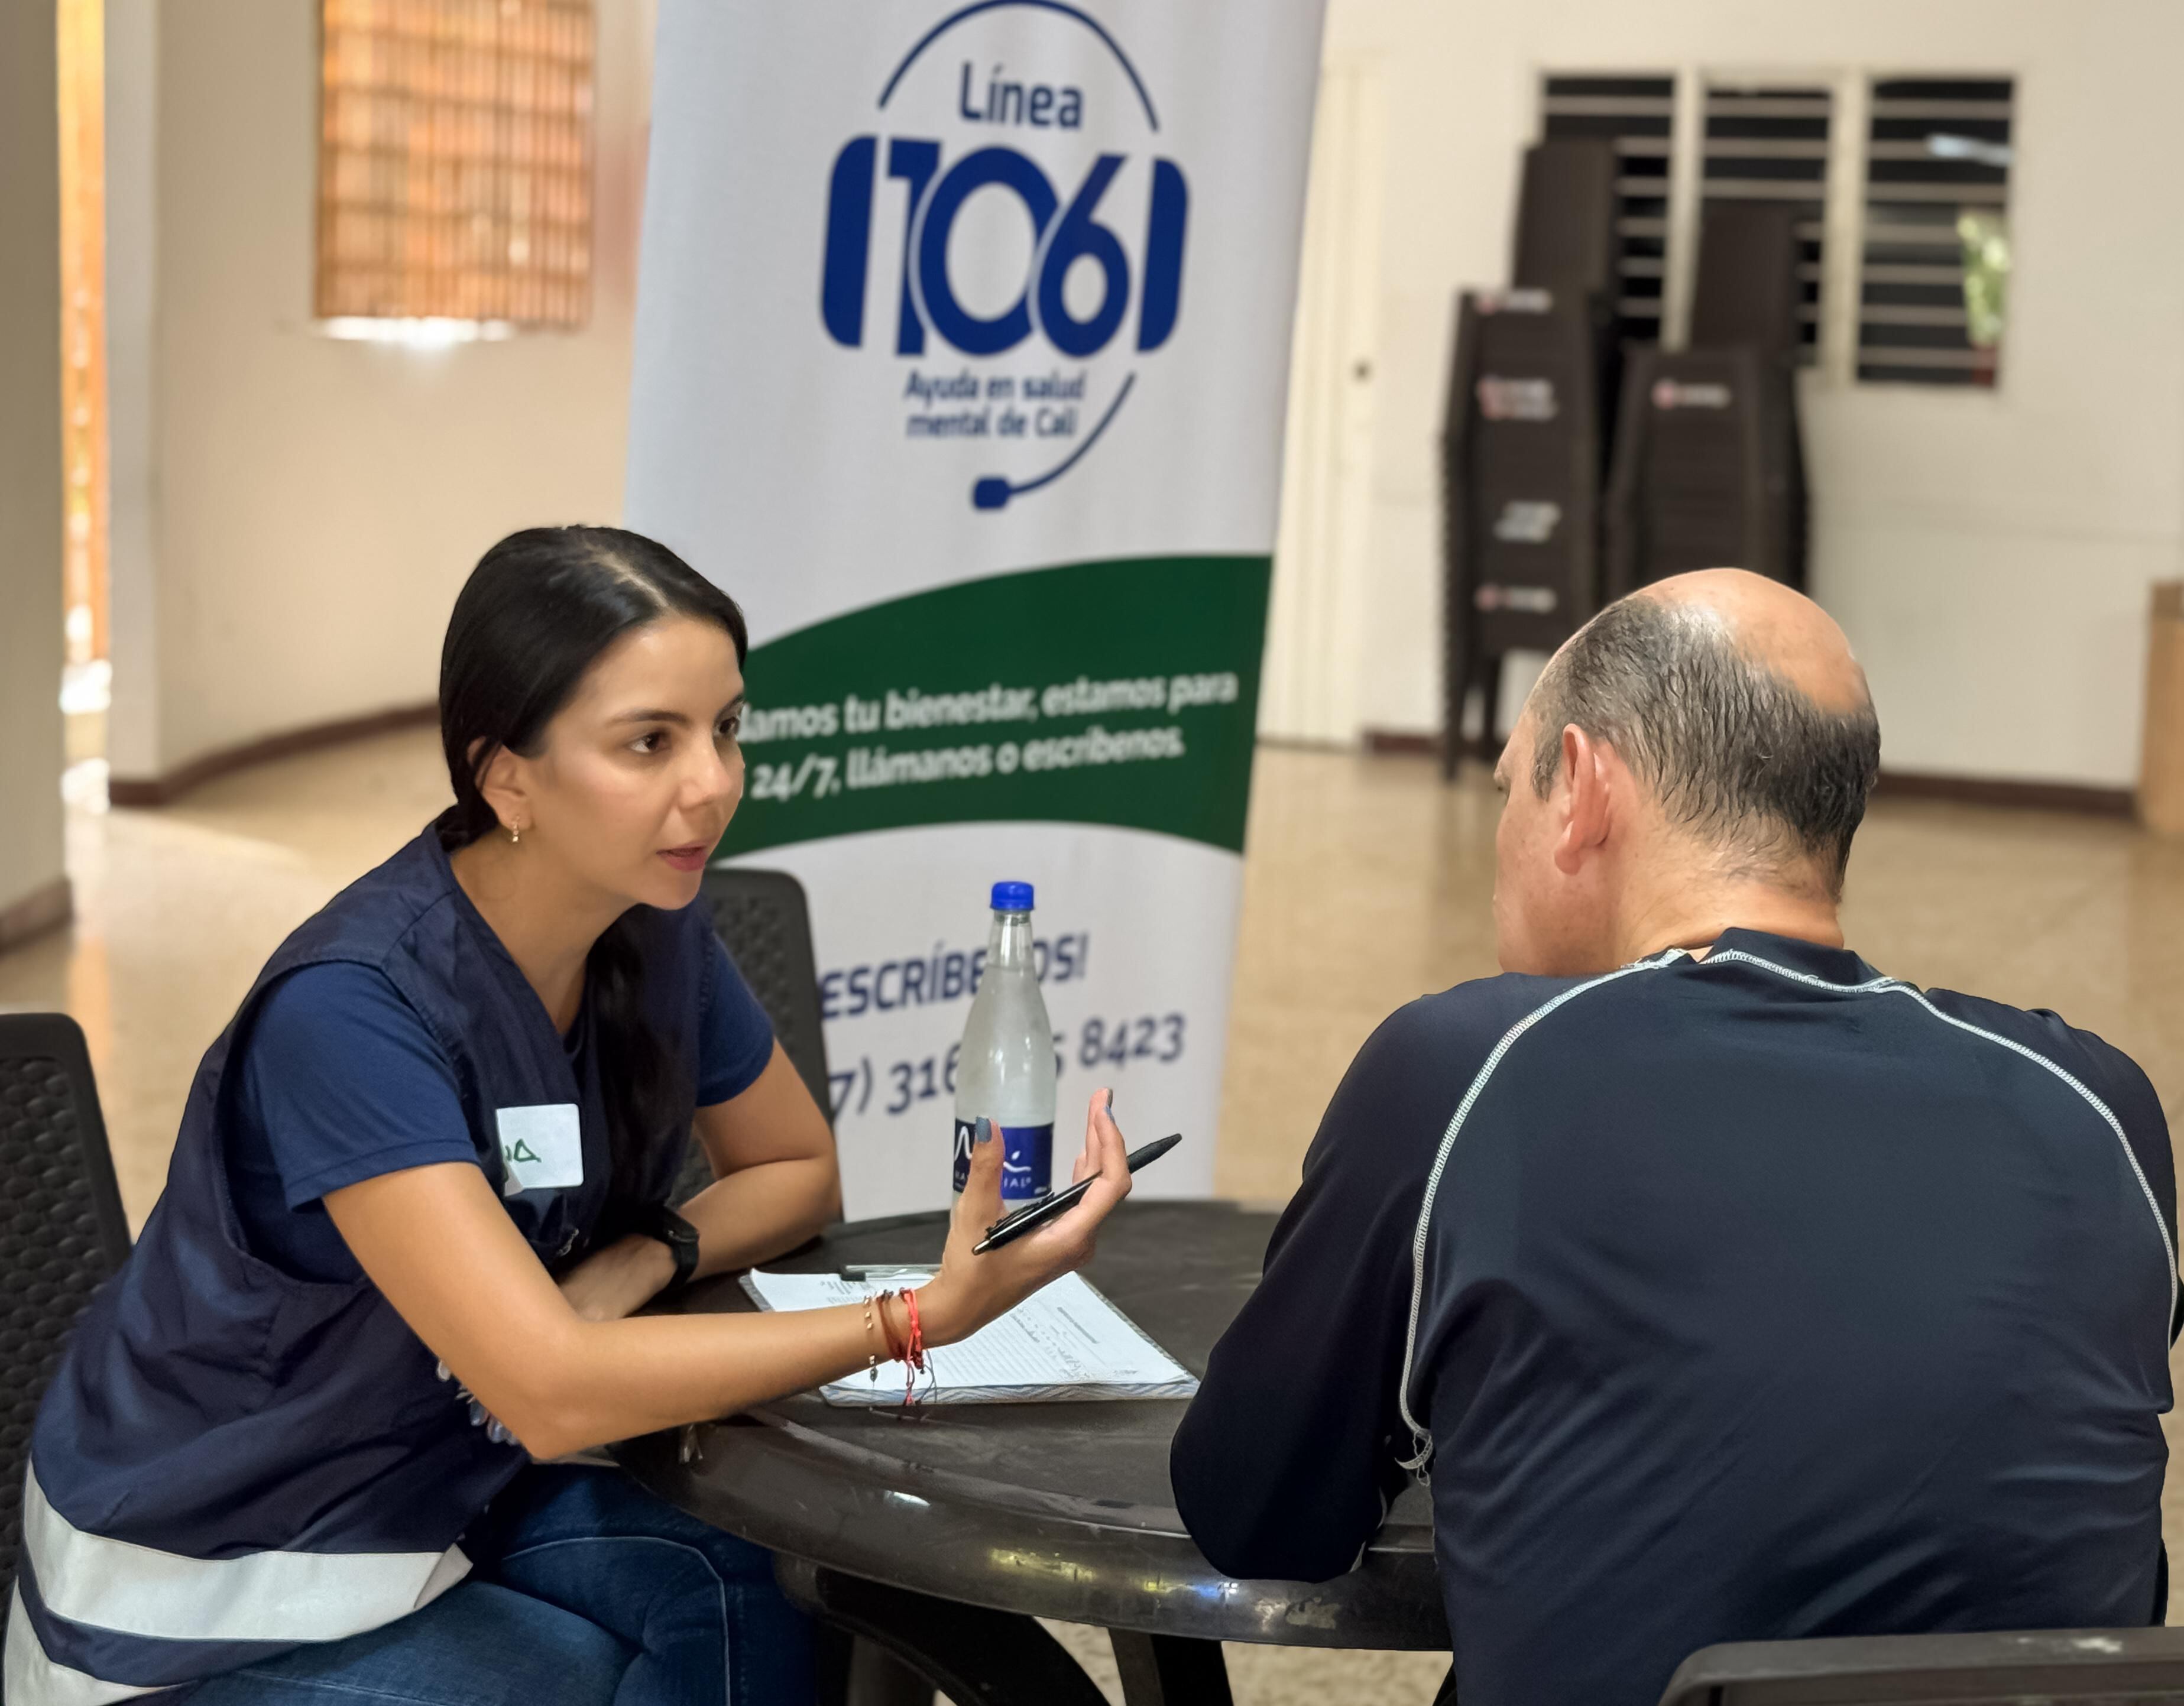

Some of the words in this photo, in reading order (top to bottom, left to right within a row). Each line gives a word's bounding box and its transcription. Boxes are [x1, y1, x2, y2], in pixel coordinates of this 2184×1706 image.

[959, 61, 1083, 128] Línea
[903, 369, 979, 408] Ayuda
[987, 376, 1015, 398] en
[1022, 369, 1086, 400] salud
[906, 407, 990, 437] mental
[997, 407, 1027, 436] de
[1036, 406, 1078, 437] Cali
[844, 695, 880, 734] tu
[884, 682, 1039, 730] bienestar,
[1042, 675, 1166, 718] estamos
[1167, 672, 1239, 716] para
[846, 745, 993, 790] llámanos
[996, 741, 1020, 775] o
[1078, 1012, 1187, 1071] 8423
